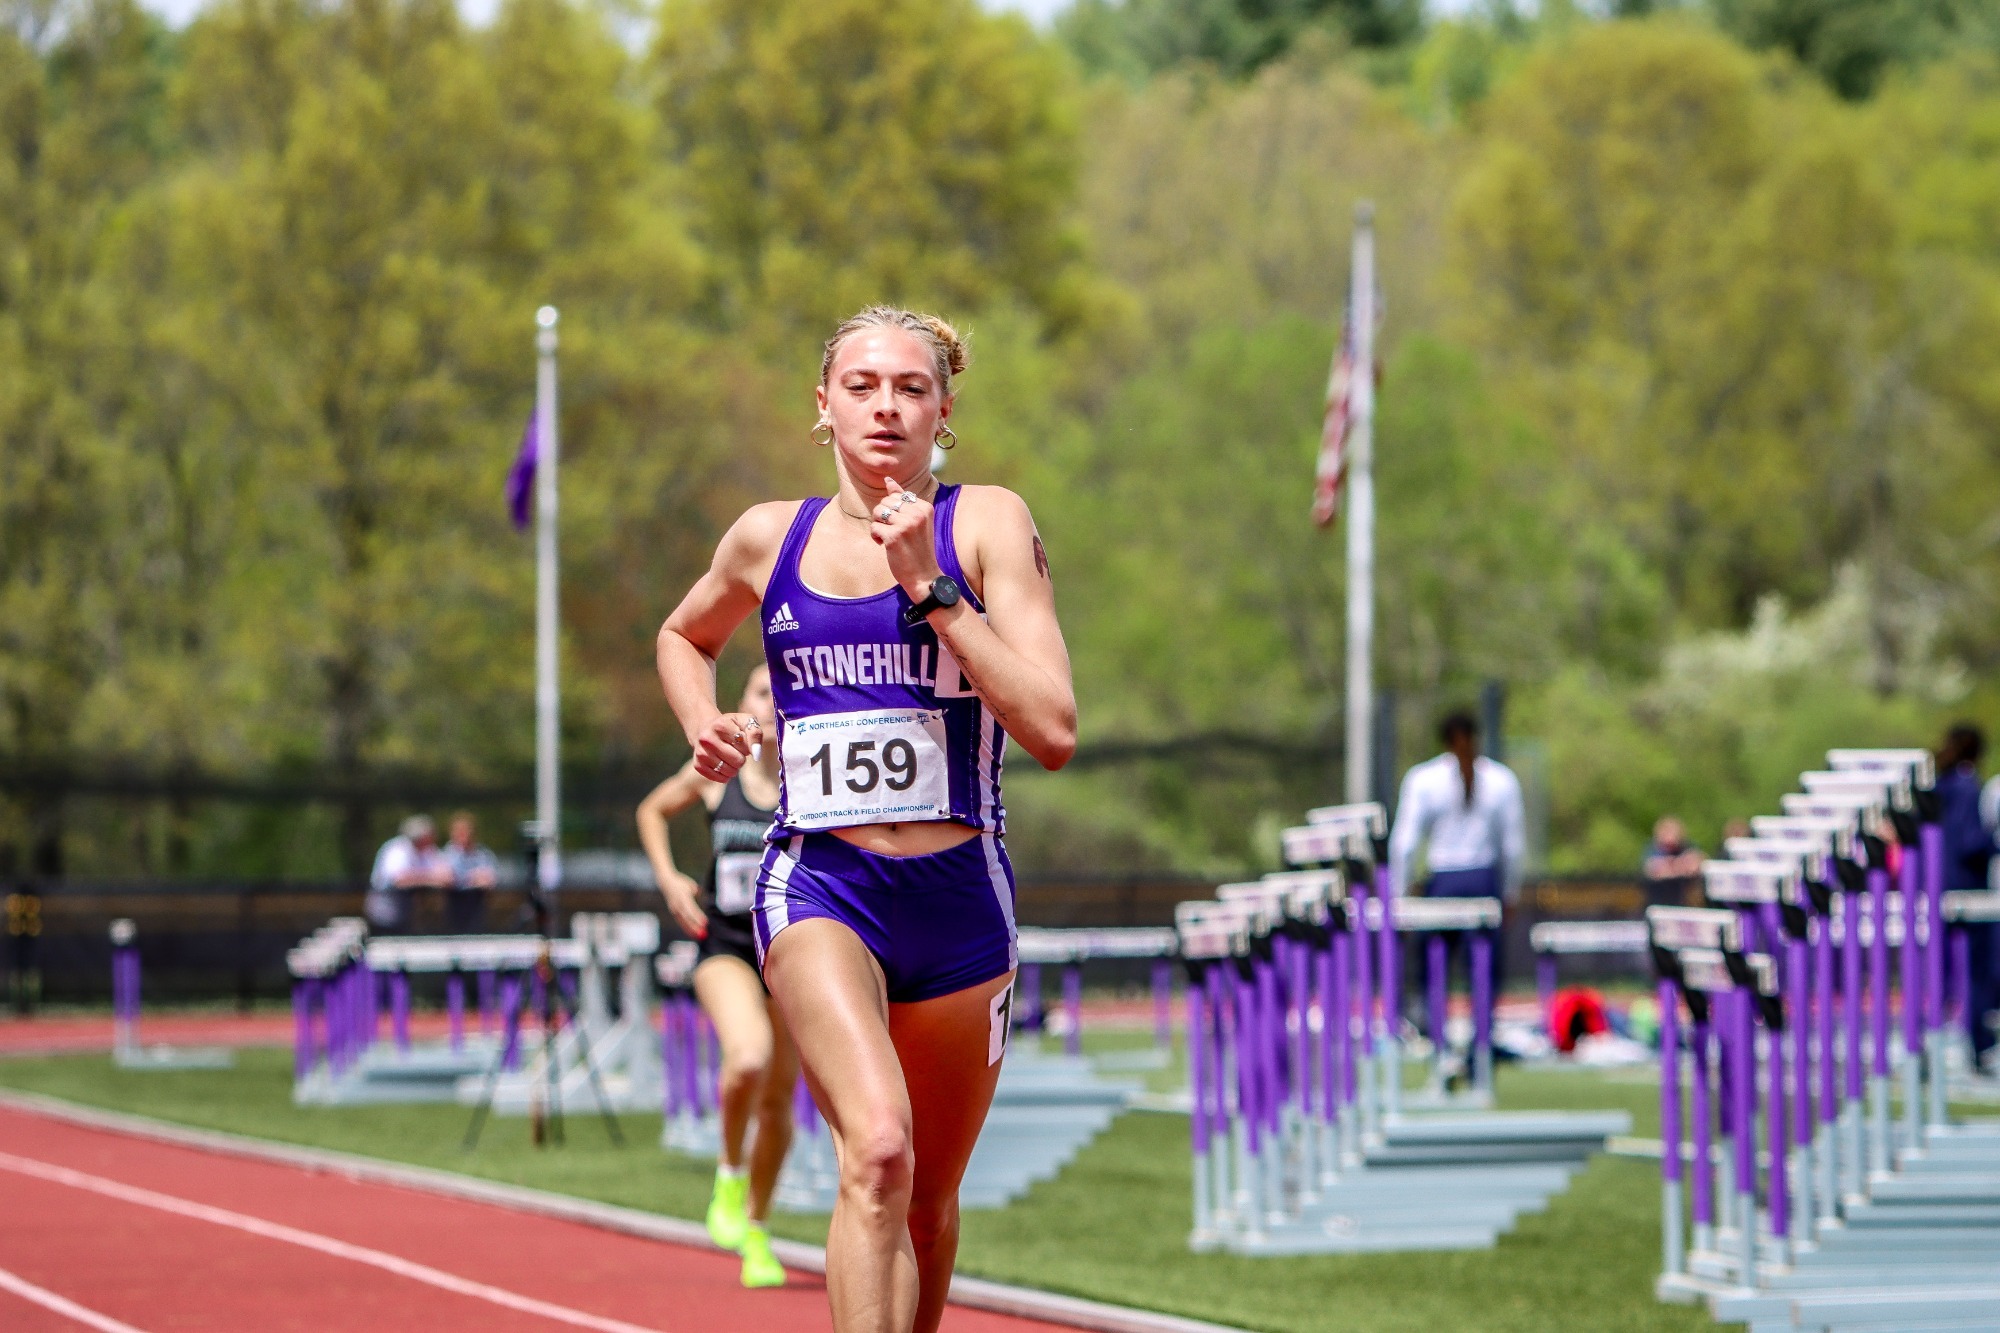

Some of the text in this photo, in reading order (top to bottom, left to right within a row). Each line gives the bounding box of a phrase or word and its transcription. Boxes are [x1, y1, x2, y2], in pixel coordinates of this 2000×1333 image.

[768, 620, 799, 634] adidas
[783, 643, 935, 690] STONEHILL
[809, 719, 854, 731] NORTHEAST
[856, 715, 912, 726] CONFERENCE
[810, 737, 918, 796] 159
[799, 811, 828, 821] OUTDOOR
[829, 808, 853, 818] TRACK
[861, 807, 881, 815] FIELD
[882, 804, 935, 814] CHAMPIONSHIP
[997, 986, 1012, 1048] 1
